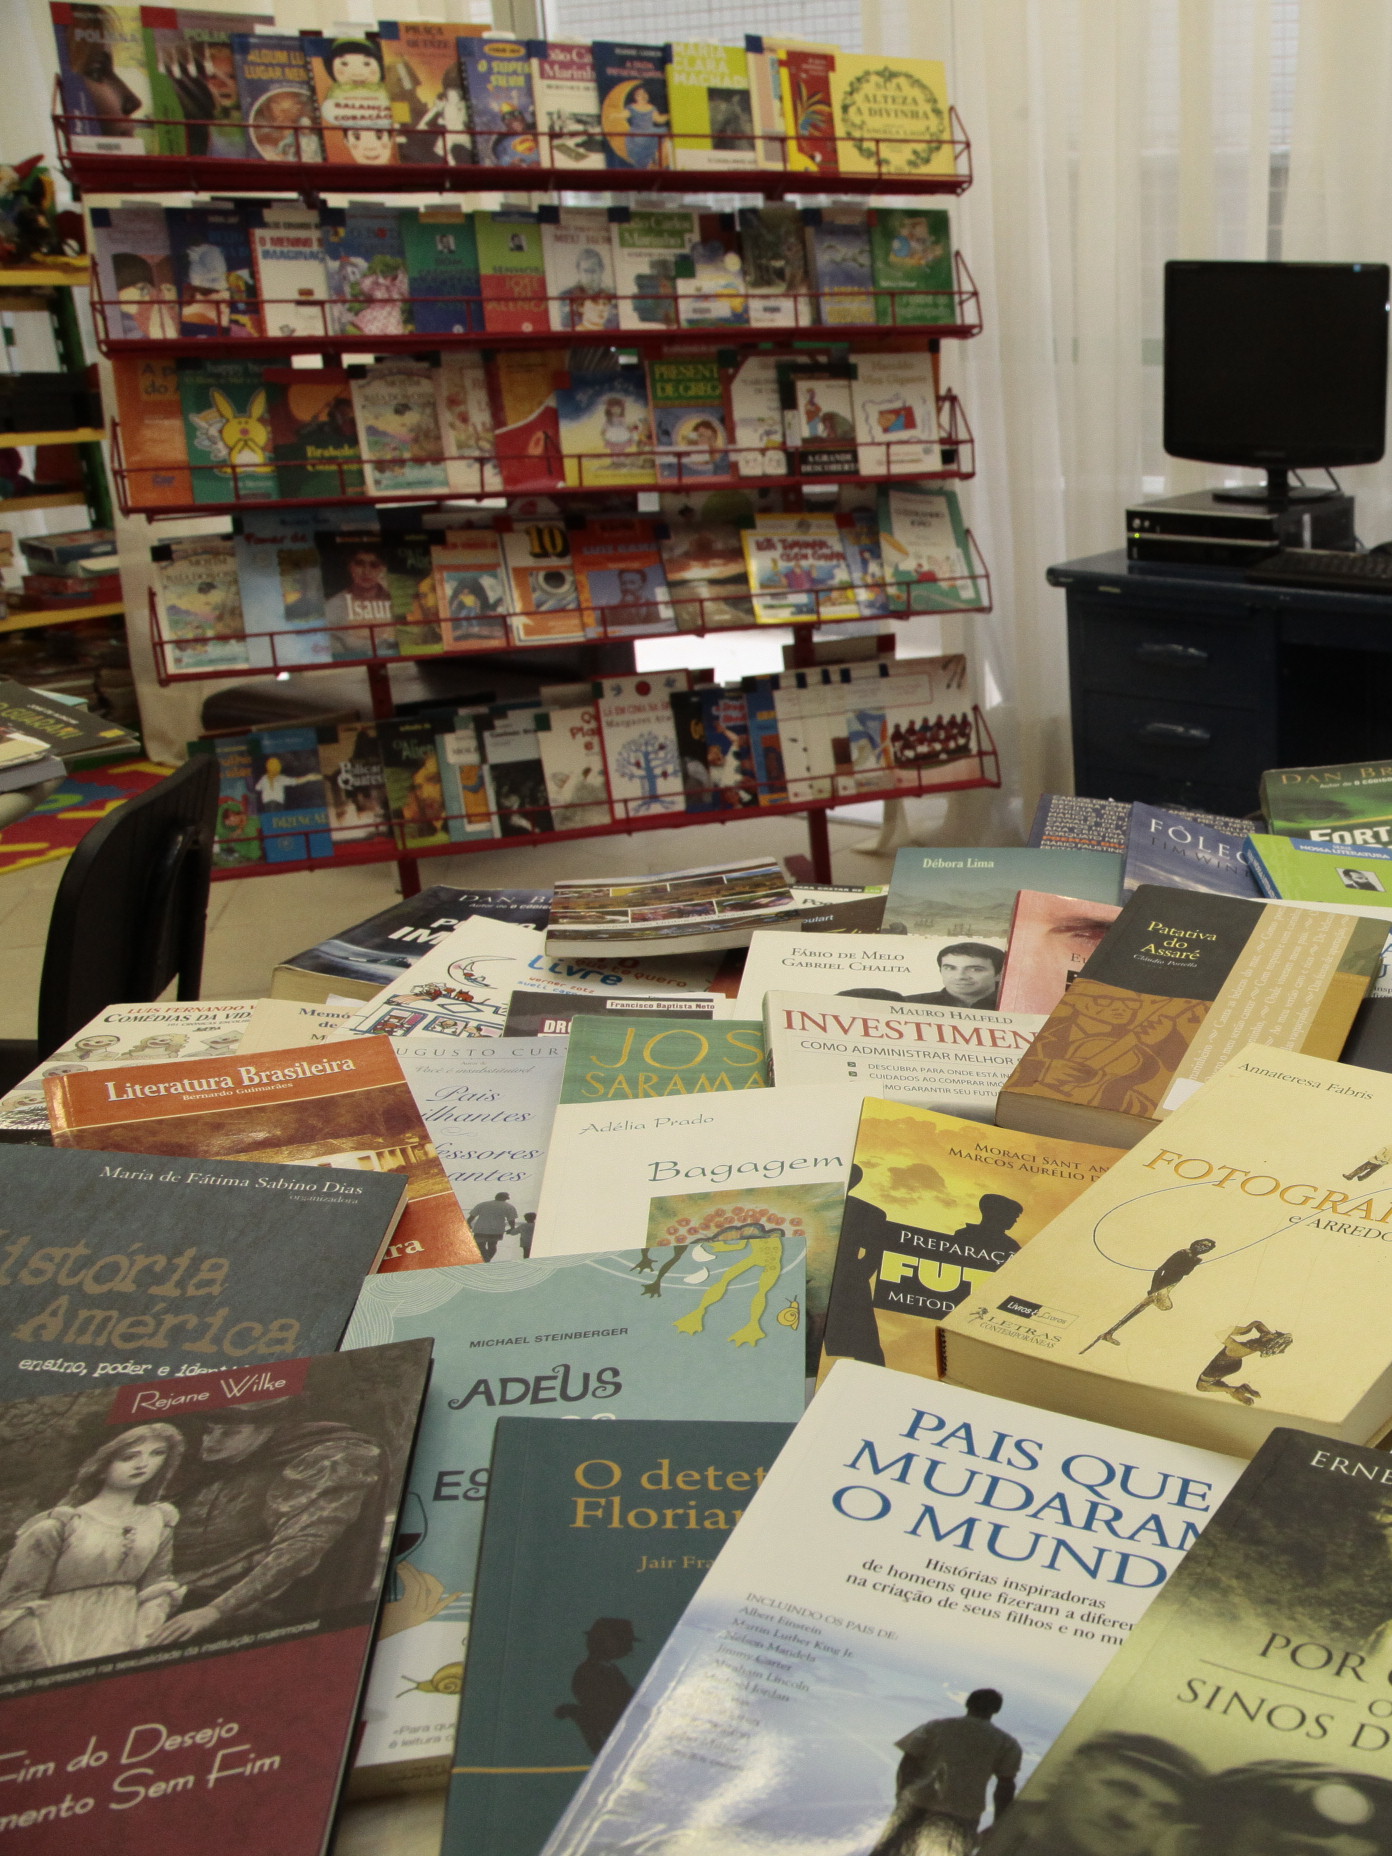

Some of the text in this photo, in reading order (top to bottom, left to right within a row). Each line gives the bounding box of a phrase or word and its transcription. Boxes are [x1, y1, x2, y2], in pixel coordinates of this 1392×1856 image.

[1282, 772, 1342, 785] DAN
[923, 858, 994, 870] Débora Lima
[1147, 920, 1217, 942] Patativa
[792, 948, 834, 959] FÁBIO
[861, 951, 905, 961] MELO
[1140, 942, 1200, 961] Assaré
[1164, 938, 1188, 950] do
[781, 958, 911, 973] GABRIEL CHALITA
[103, 1010, 219, 1024] COMÉDIAS DA
[656, 1002, 693, 1010] Baptista
[889, 1006, 1013, 1024] MAURO HALFELD
[801, 1040, 1014, 1066] COMO ADMINISTRAR MELHOR
[105, 1056, 356, 1101] Literatura Brasileira
[1239, 1060, 1374, 1101] Annateresa Fabris
[182, 1081, 294, 1101] Bernardo Guimarães
[426, 1084, 502, 1102] Pais
[579, 1114, 715, 1136] Adélia Prado
[949, 1147, 1016, 1170] MARCOS
[974, 1142, 1037, 1164] MORACI
[99, 1166, 364, 1195] Maria de Fátima Sabino Dias
[648, 1153, 846, 1186] Bagagem
[1287, 1214, 1302, 1225] e
[12, 1295, 302, 1358] América
[469, 1327, 629, 1349] MICHAEL STEINBERGER
[988, 1316, 1062, 1342] LETRAS
[18, 1359, 168, 1378] ensino, poder e
[131, 1372, 287, 1414] Rejane Wilke
[447, 1363, 623, 1410] ADEUS
[900, 1406, 1214, 1513] PAIS QUE
[573, 1460, 623, 1489] O
[830, 1484, 893, 1522] O
[925, 1557, 1107, 1610] Histórias inspiradoras
[1258, 1631, 1368, 1684] POR
[1176, 1675, 1337, 1741] SINOS
[66, 1718, 240, 1773] do Desejo
[109, 1744, 281, 1810] Sem Fim
